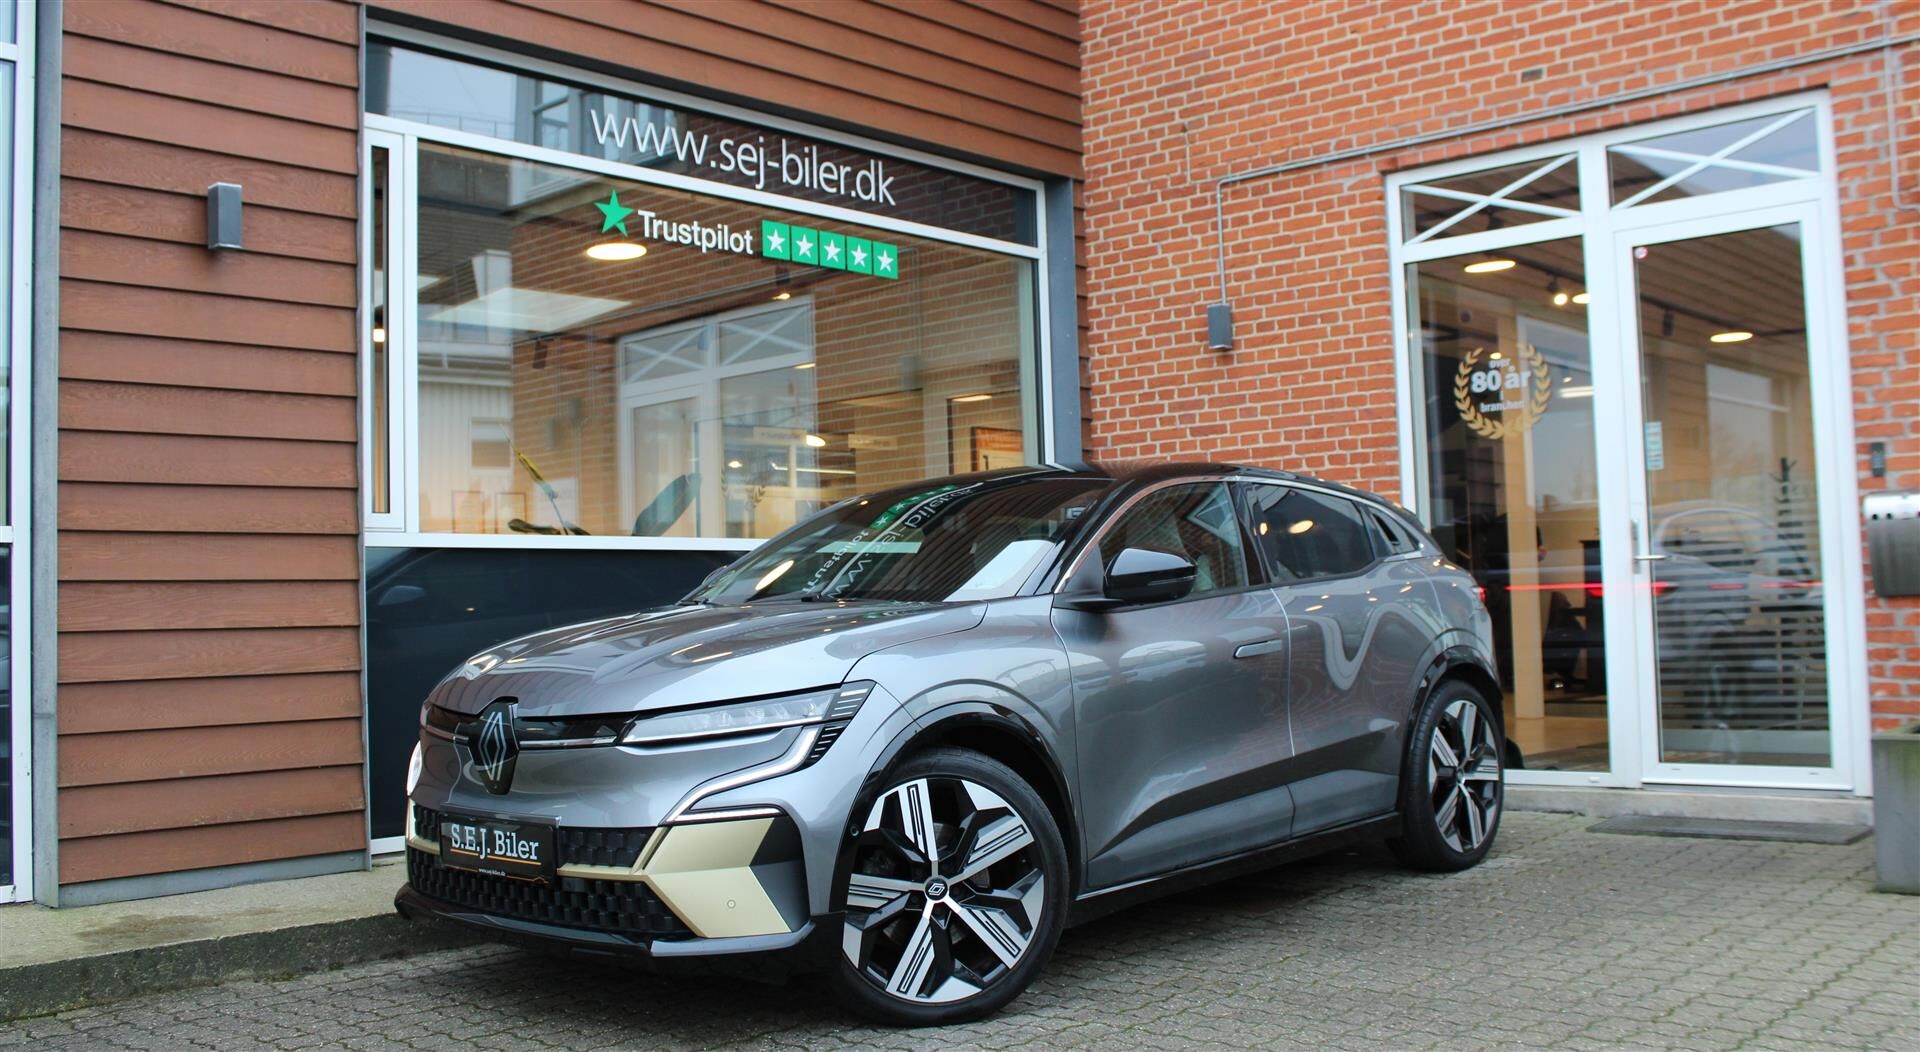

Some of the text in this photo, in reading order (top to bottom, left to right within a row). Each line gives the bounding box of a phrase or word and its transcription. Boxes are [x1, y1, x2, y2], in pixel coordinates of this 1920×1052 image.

[590, 108, 896, 206] www.sej-biler.dk
[638, 209, 754, 255] Trustpilot
[1471, 365, 1531, 393] 80 år
[451, 823, 539, 860] S.E.J. Biler
